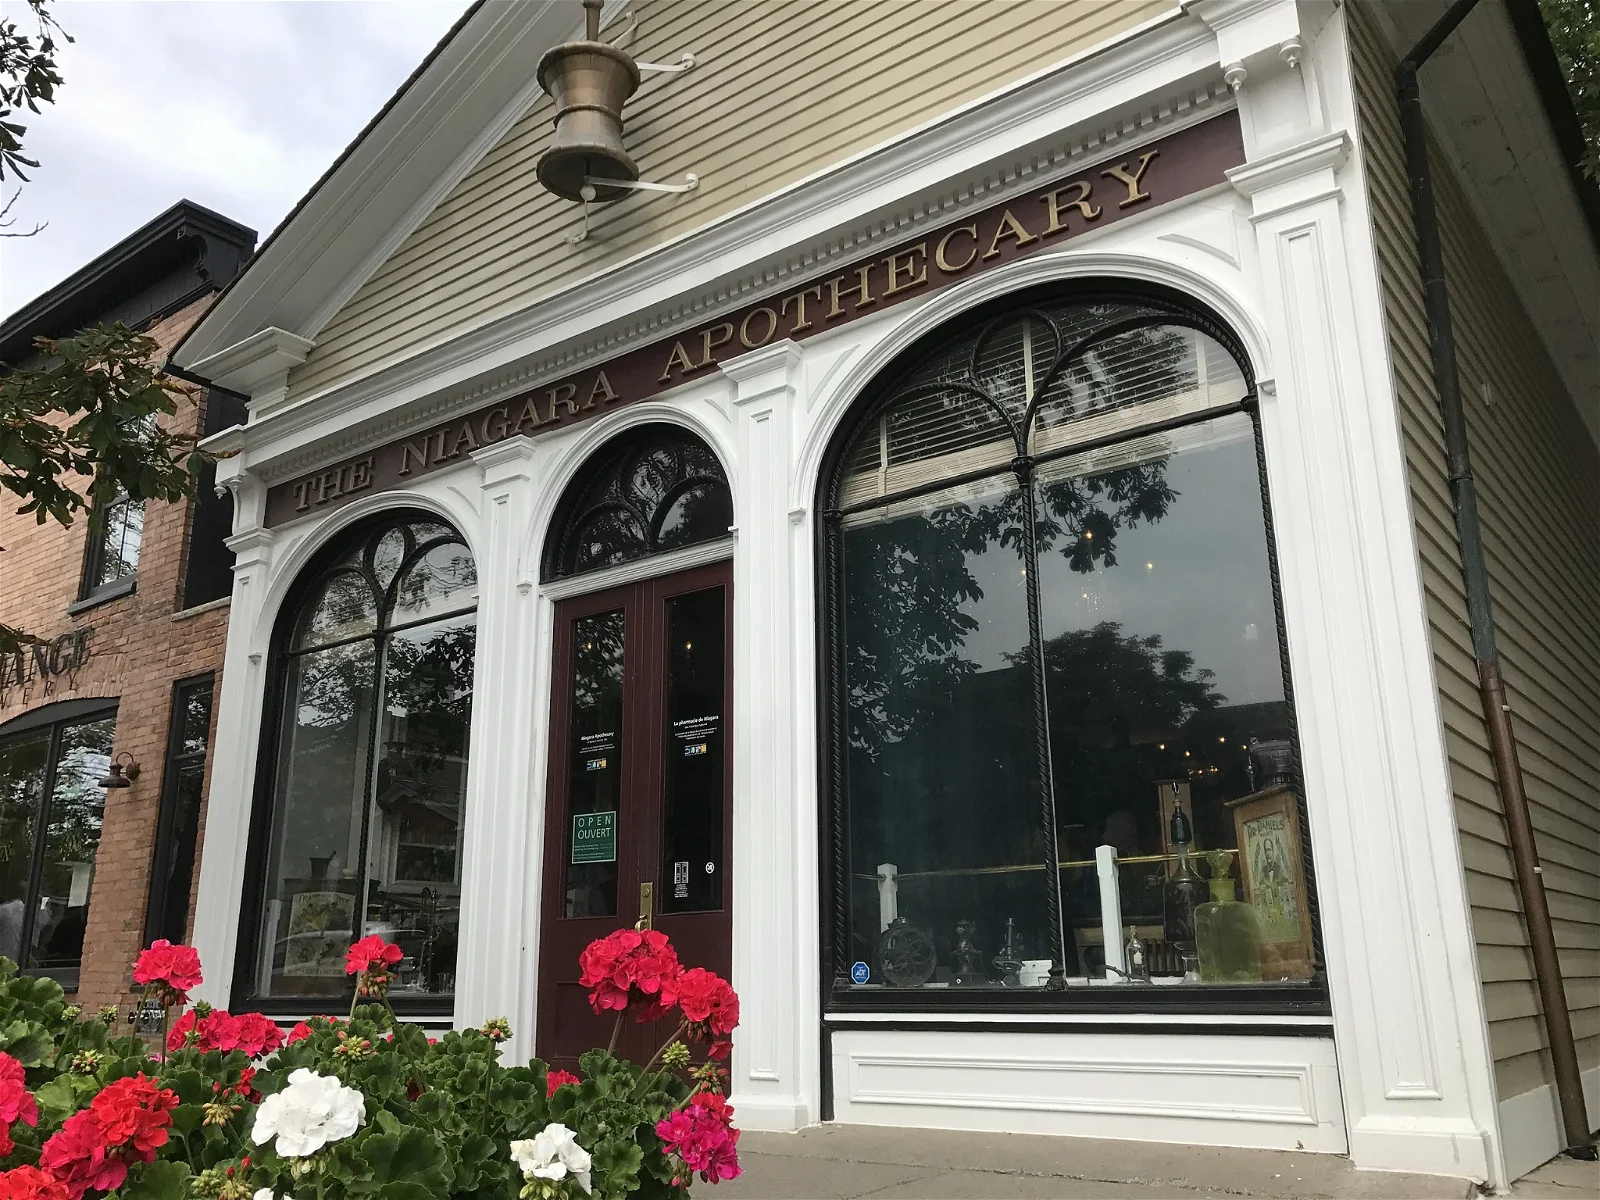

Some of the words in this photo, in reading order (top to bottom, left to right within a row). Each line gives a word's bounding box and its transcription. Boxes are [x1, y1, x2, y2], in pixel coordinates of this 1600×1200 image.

[293, 456, 375, 513] THE
[398, 370, 621, 476] NIAGARA
[656, 149, 1161, 383] APOTHECARY
[0, 625, 93, 688] ANGE
[577, 815, 612, 828] OPEN
[577, 827, 612, 840] OUVERT
